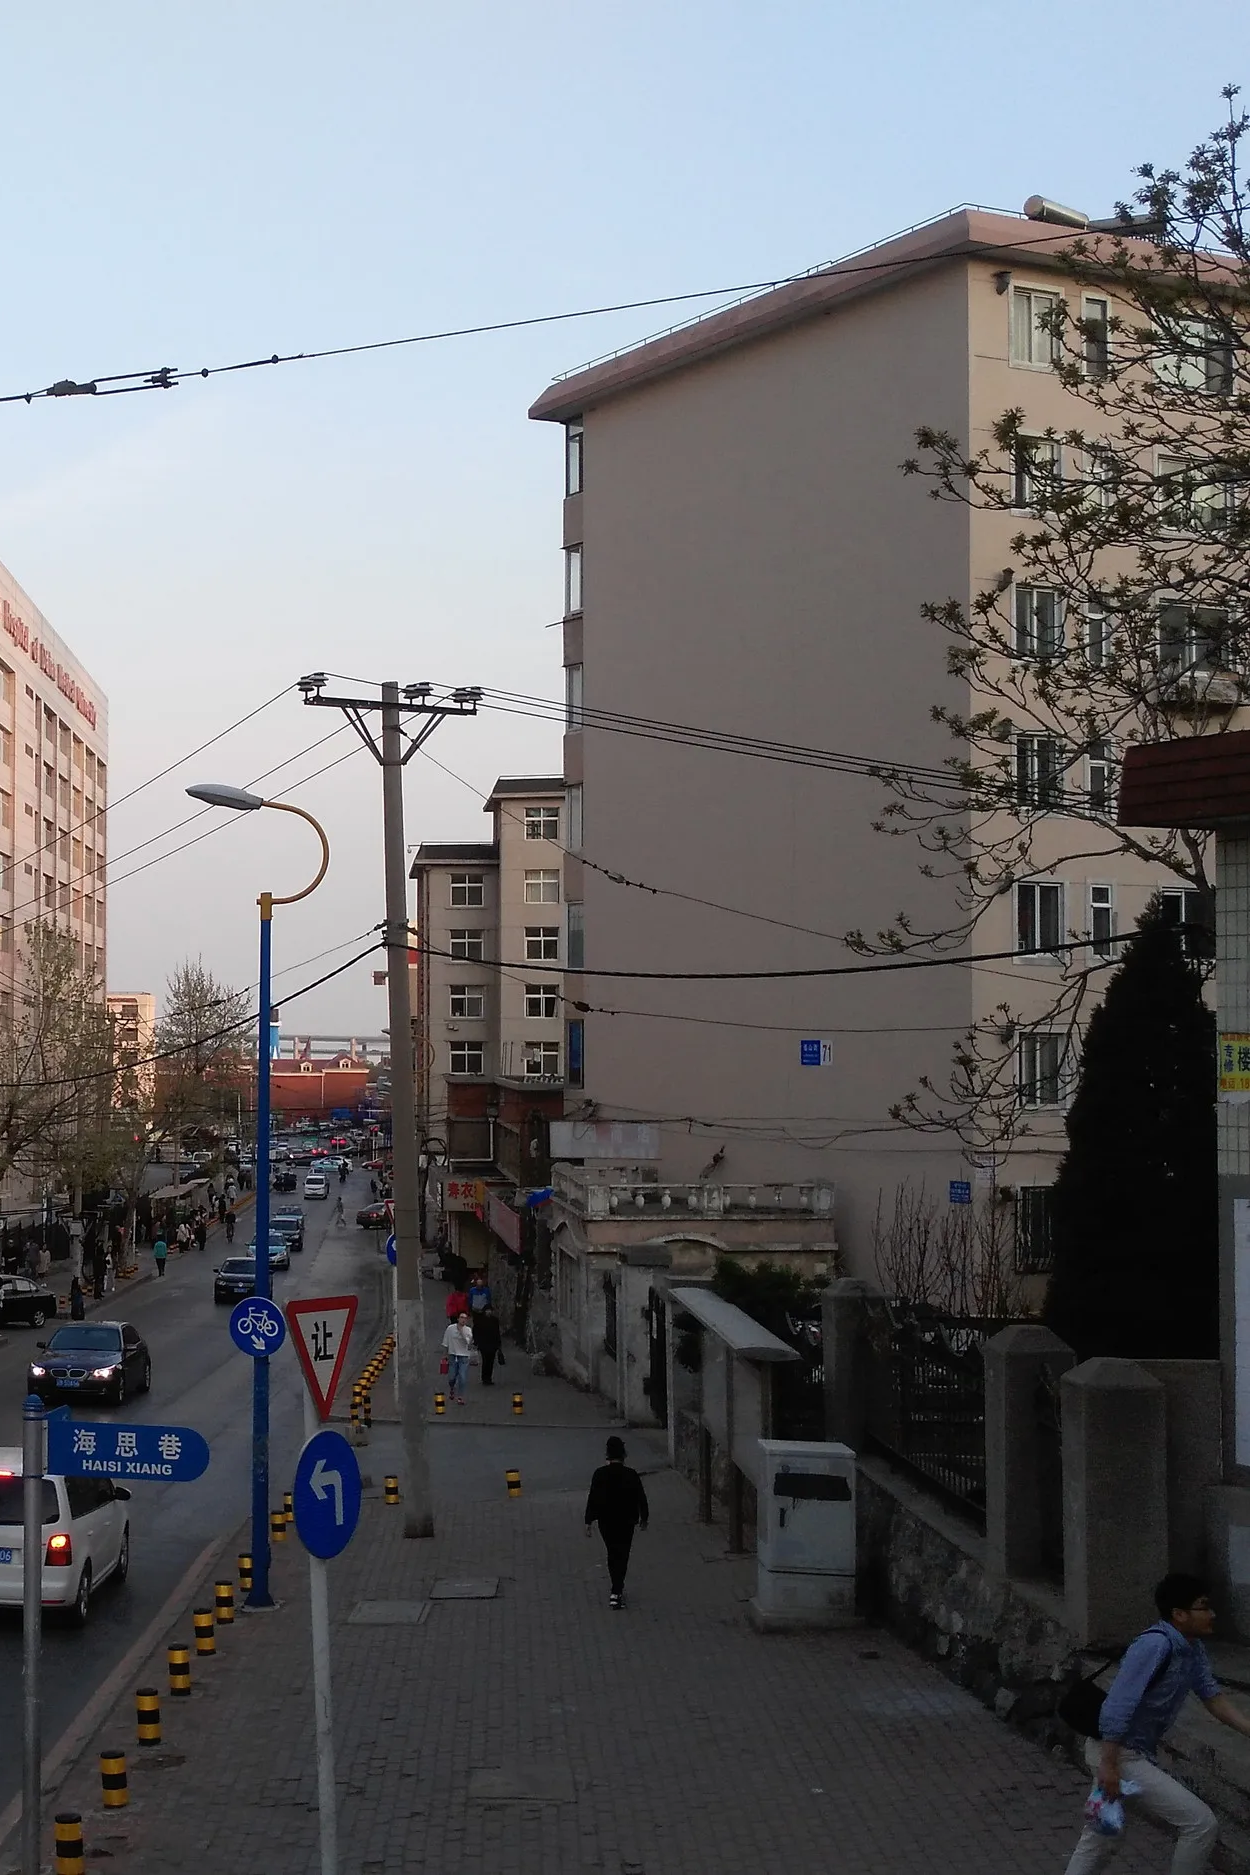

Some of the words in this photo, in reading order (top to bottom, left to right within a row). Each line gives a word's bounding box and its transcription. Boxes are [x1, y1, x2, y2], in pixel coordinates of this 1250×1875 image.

[823, 1044, 831, 1062] 71
[311, 1320, 335, 1362] 让
[73, 1428, 182, 1461] 海思巷
[82, 1459, 121, 1473] HAISI
[125, 1462, 173, 1476] XIANG
